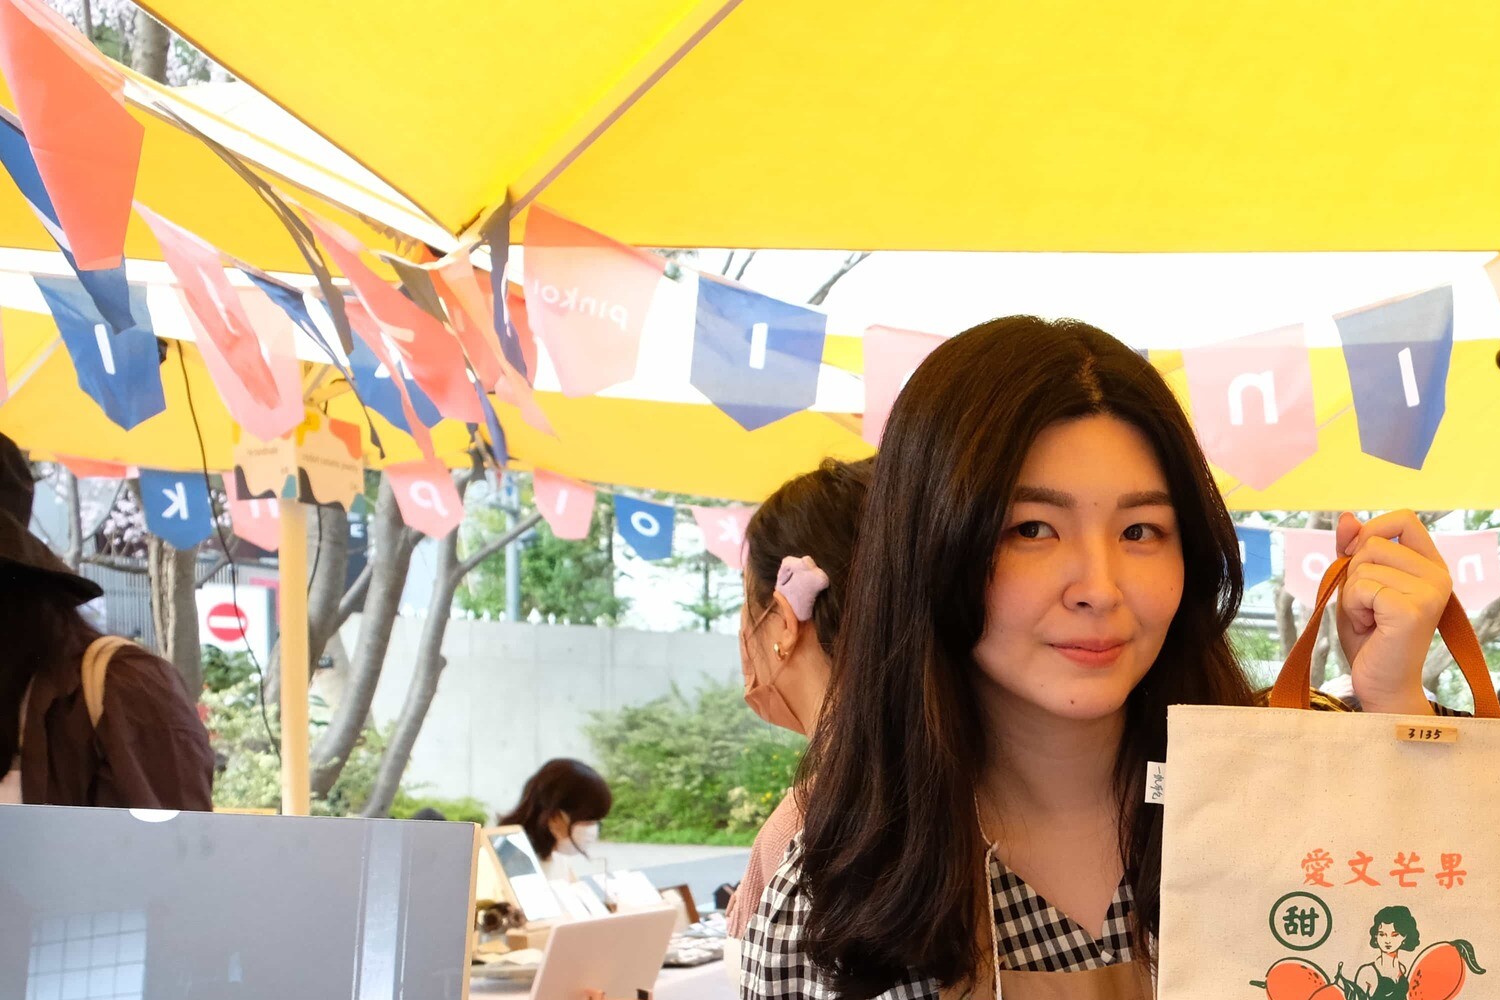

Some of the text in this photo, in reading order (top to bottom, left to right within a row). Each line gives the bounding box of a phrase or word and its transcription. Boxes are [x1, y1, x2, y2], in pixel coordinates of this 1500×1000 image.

[1300, 848, 1469, 889] 愛文芒果
[1282, 905, 1320, 938] 甜
